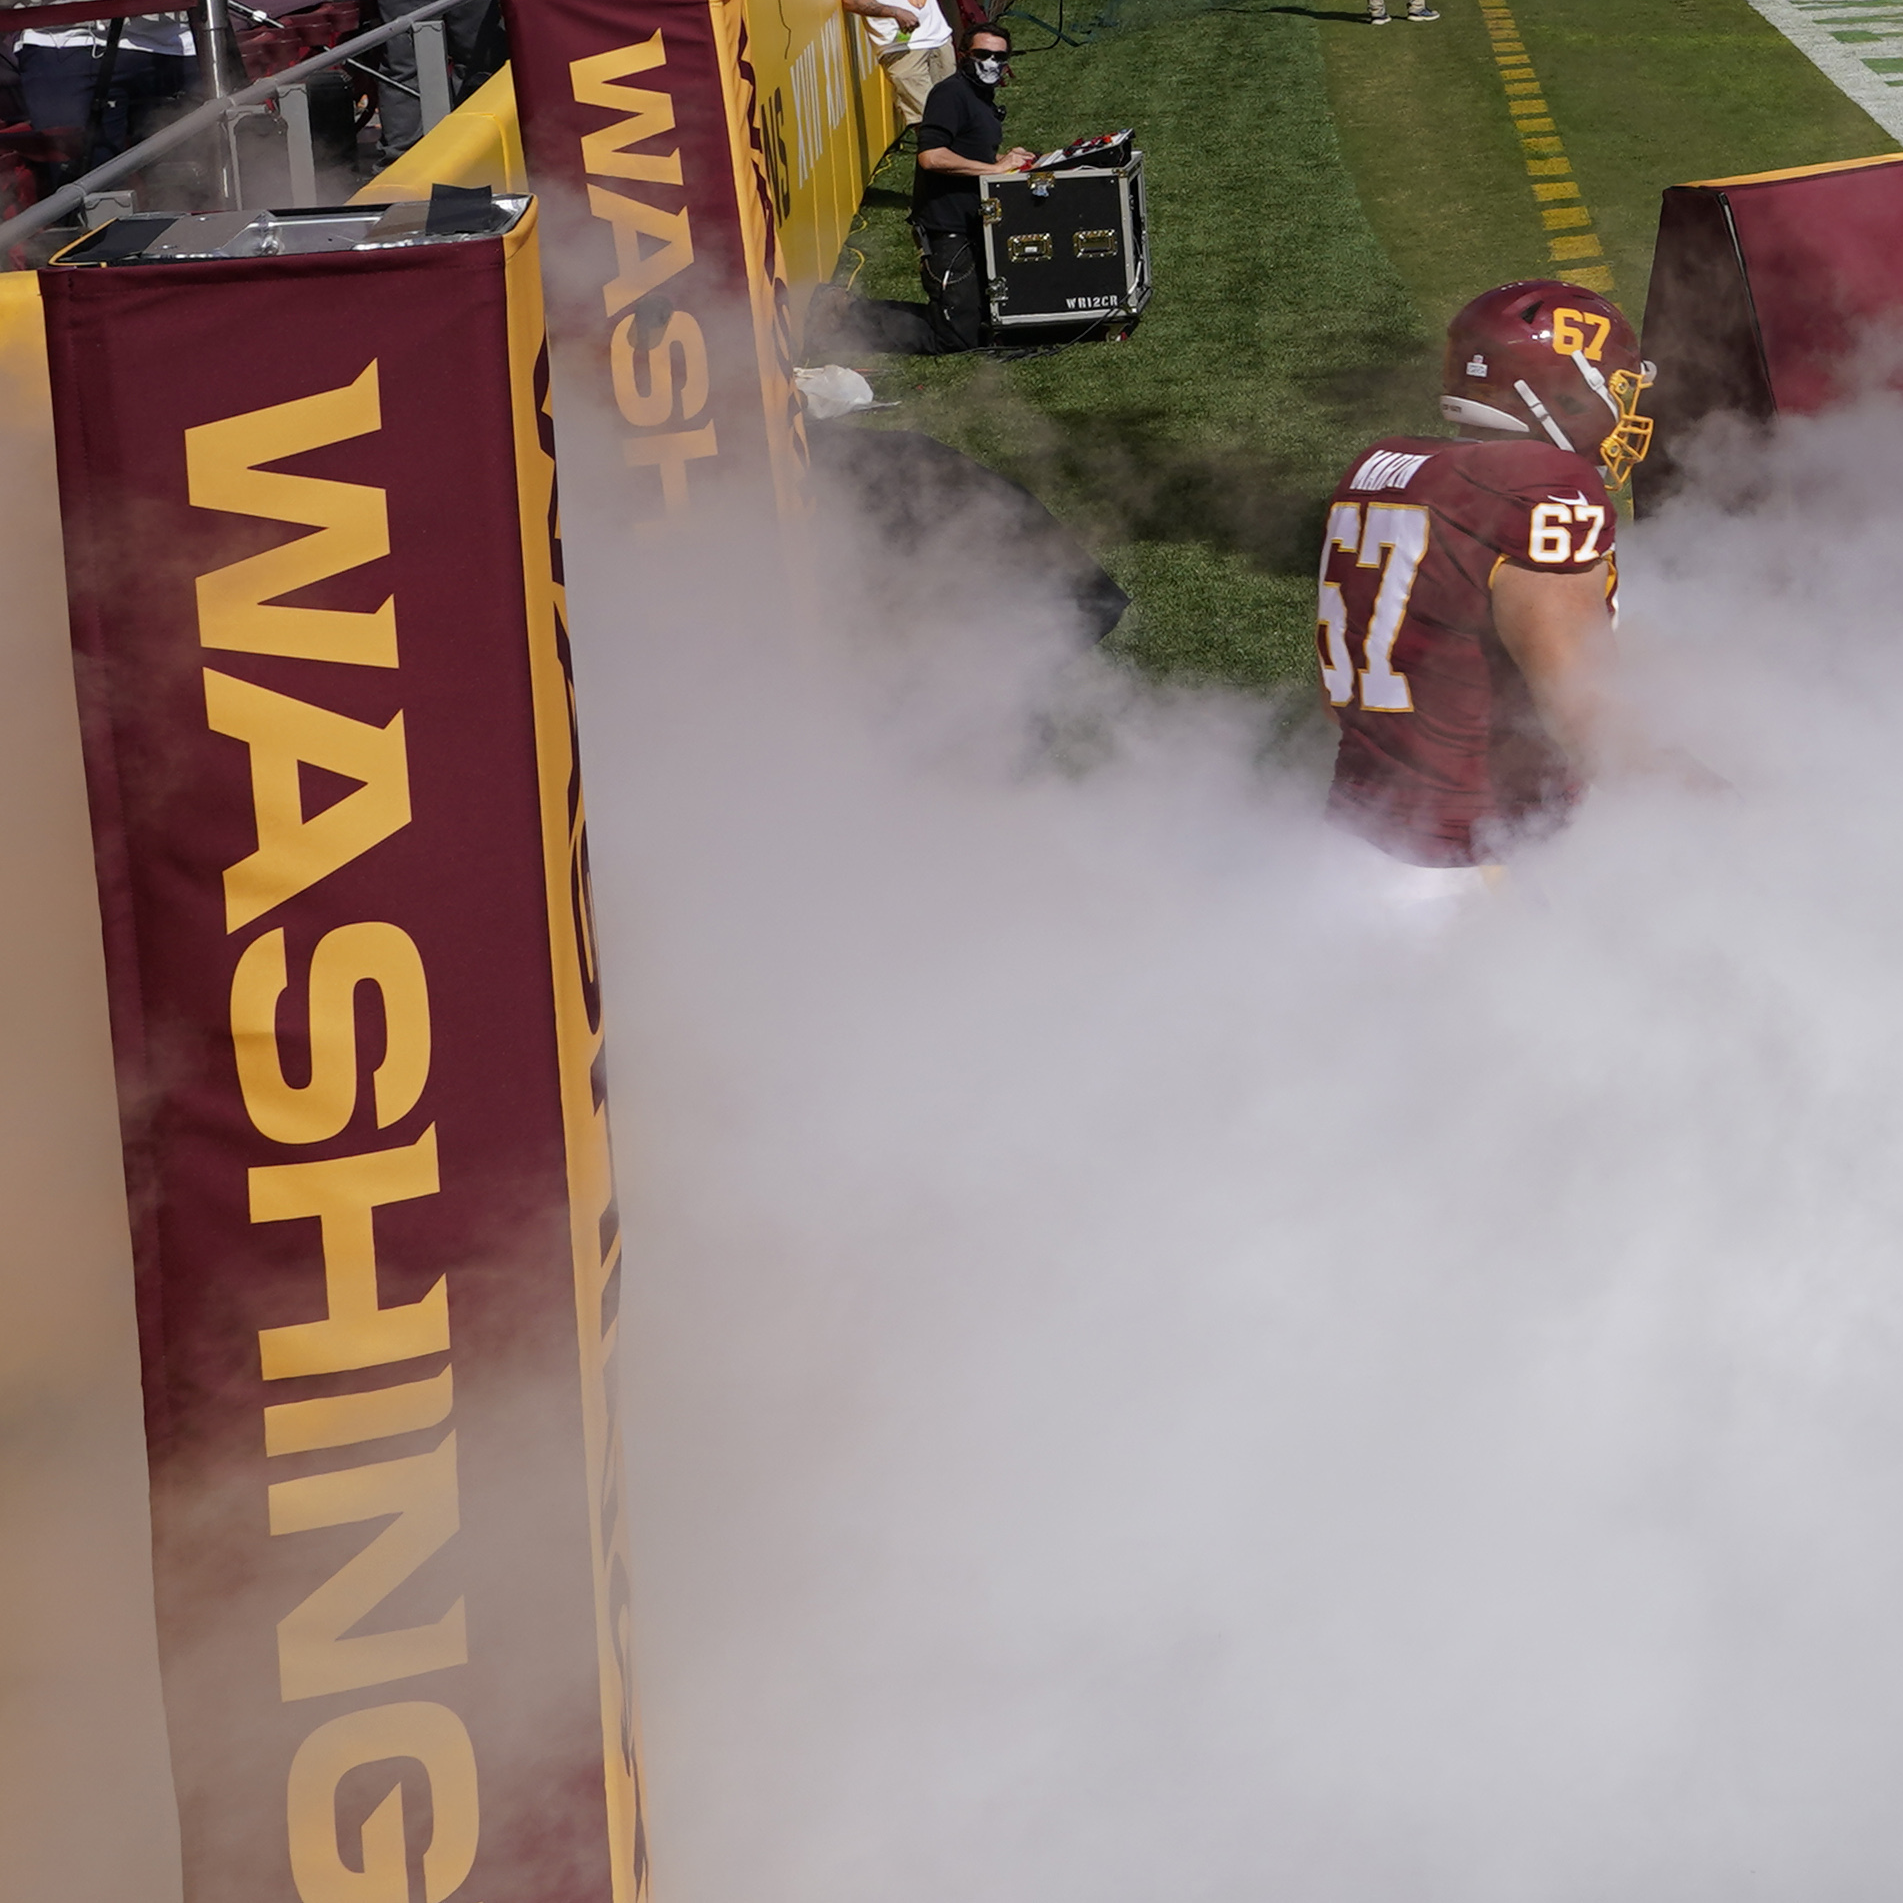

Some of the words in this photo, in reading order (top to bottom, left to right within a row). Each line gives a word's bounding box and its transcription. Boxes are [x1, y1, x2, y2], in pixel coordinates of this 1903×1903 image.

[1551, 306, 1611, 362] 67
[1527, 502, 1606, 564] 67
[1315, 500, 1431, 714] 67
